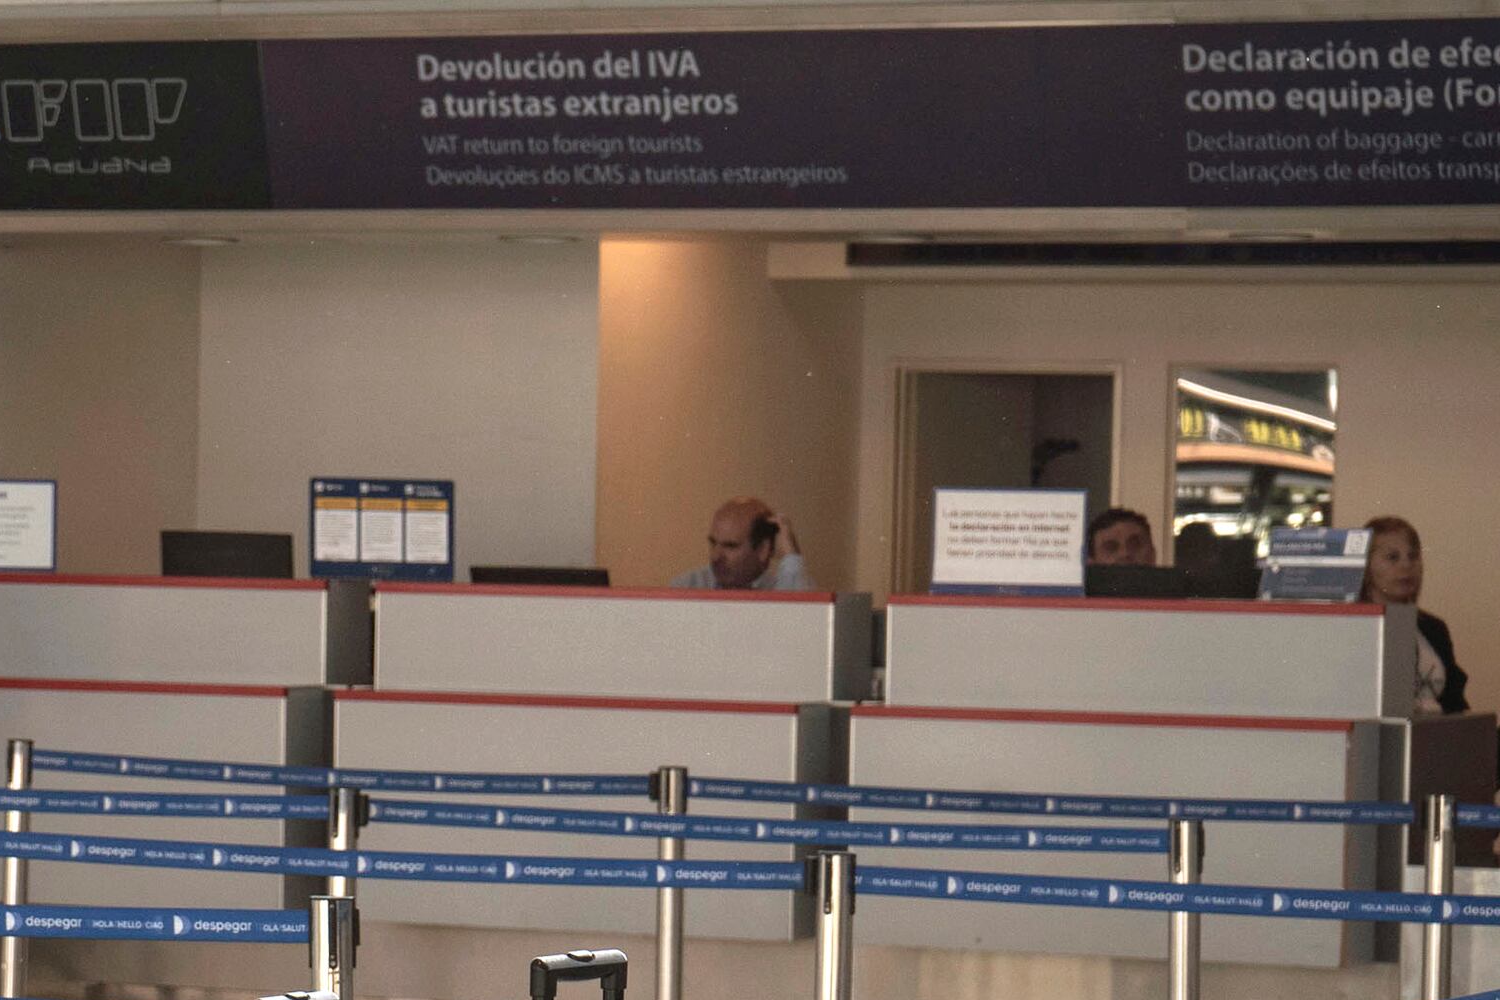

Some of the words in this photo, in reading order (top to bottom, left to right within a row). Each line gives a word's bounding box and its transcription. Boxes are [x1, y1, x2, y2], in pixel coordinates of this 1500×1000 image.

[417, 51, 586, 82] Devolución
[593, 50, 640, 78] del
[647, 50, 700, 78] IVA
[1182, 41, 1379, 73] Declaración
[1388, 38, 1430, 69] de
[420, 98, 437, 118] a
[444, 90, 556, 117] turistas
[563, 86, 739, 121] extranjeros
[1185, 88, 1276, 112] como
[1284, 79, 1434, 117] equipaje
[1444, 77, 1500, 110] (Fo
[422, 134, 459, 155] VAT
[463, 135, 524, 155] return
[527, 136, 549, 154] to
[552, 134, 624, 159] foreign
[628, 134, 703, 154] tourists
[1186, 128, 1310, 152] Declaration
[1316, 129, 1340, 150] of
[1345, 128, 1443, 154] baggage
[426, 164, 540, 188] Devoluções
[544, 164, 570, 185] do
[573, 164, 624, 185] ICMS
[628, 169, 641, 185] a
[645, 164, 719, 184] turistas
[722, 163, 848, 187] estrangeiros
[1187, 160, 1319, 186] Declarações
[1323, 160, 1352, 182] de
[1358, 157, 1431, 180] efeitos
[674, 868, 729, 882] despegar
[966, 880, 1022, 896] despegar
[1128, 889, 1186, 905] despegar
[1292, 897, 1351, 913] despegar
[25, 915, 83, 931] despegar
[194, 919, 253, 934] despegar
